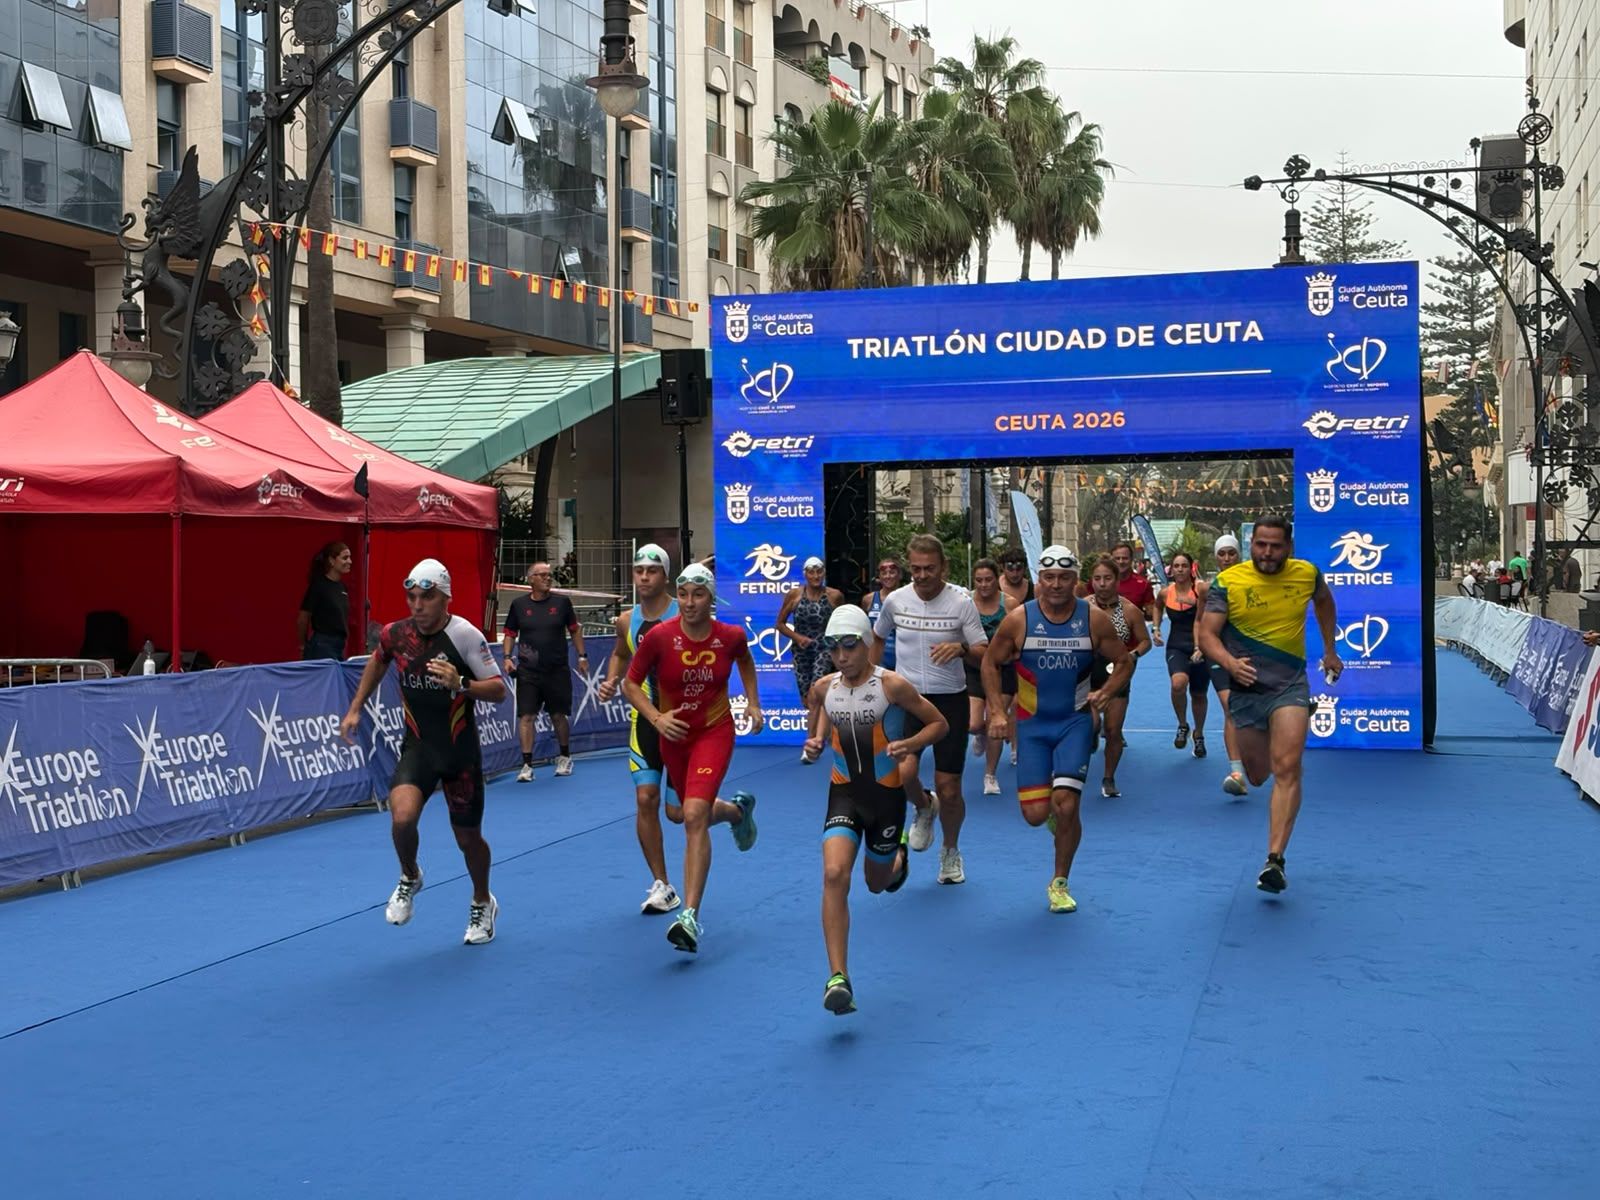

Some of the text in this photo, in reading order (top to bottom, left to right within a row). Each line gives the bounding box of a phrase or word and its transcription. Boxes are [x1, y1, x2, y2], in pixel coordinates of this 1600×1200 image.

[1338, 284, 1408, 293] Ciudad Autónoma
[1338, 292, 1408, 309] de Ceuta
[765, 321, 813, 336] Ceuta
[847, 320, 1264, 359] TRIATLÓN CIUDAD DE CEUTA
[995, 411, 1126, 431] CEUTA 2026
[1339, 481, 1409, 490] Ciudad Autónoma
[778, 495, 814, 503] Autónoma
[1339, 490, 1409, 506] de Ceuta
[766, 503, 814, 518] Ceuta
[1324, 572, 1393, 585] FETRICE
[1038, 653, 1079, 670] OCAÑA
[683, 666, 714, 682] OCAÑA
[684, 684, 705, 697] ESP
[380, 703, 405, 730] Eur
[831, 709, 875, 725] CORRALES
[1340, 707, 1410, 716] Ciudad Autónoma
[273, 714, 341, 746] Europe
[769, 716, 808, 730] Ceut
[1340, 716, 1410, 732] de Ceuta
[152, 732, 228, 767] Europe
[11, 748, 101, 789] Europe
[280, 743, 365, 782] Triathlon
[160, 764, 254, 806] Triathlon
[18, 784, 131, 833] Triathlon
